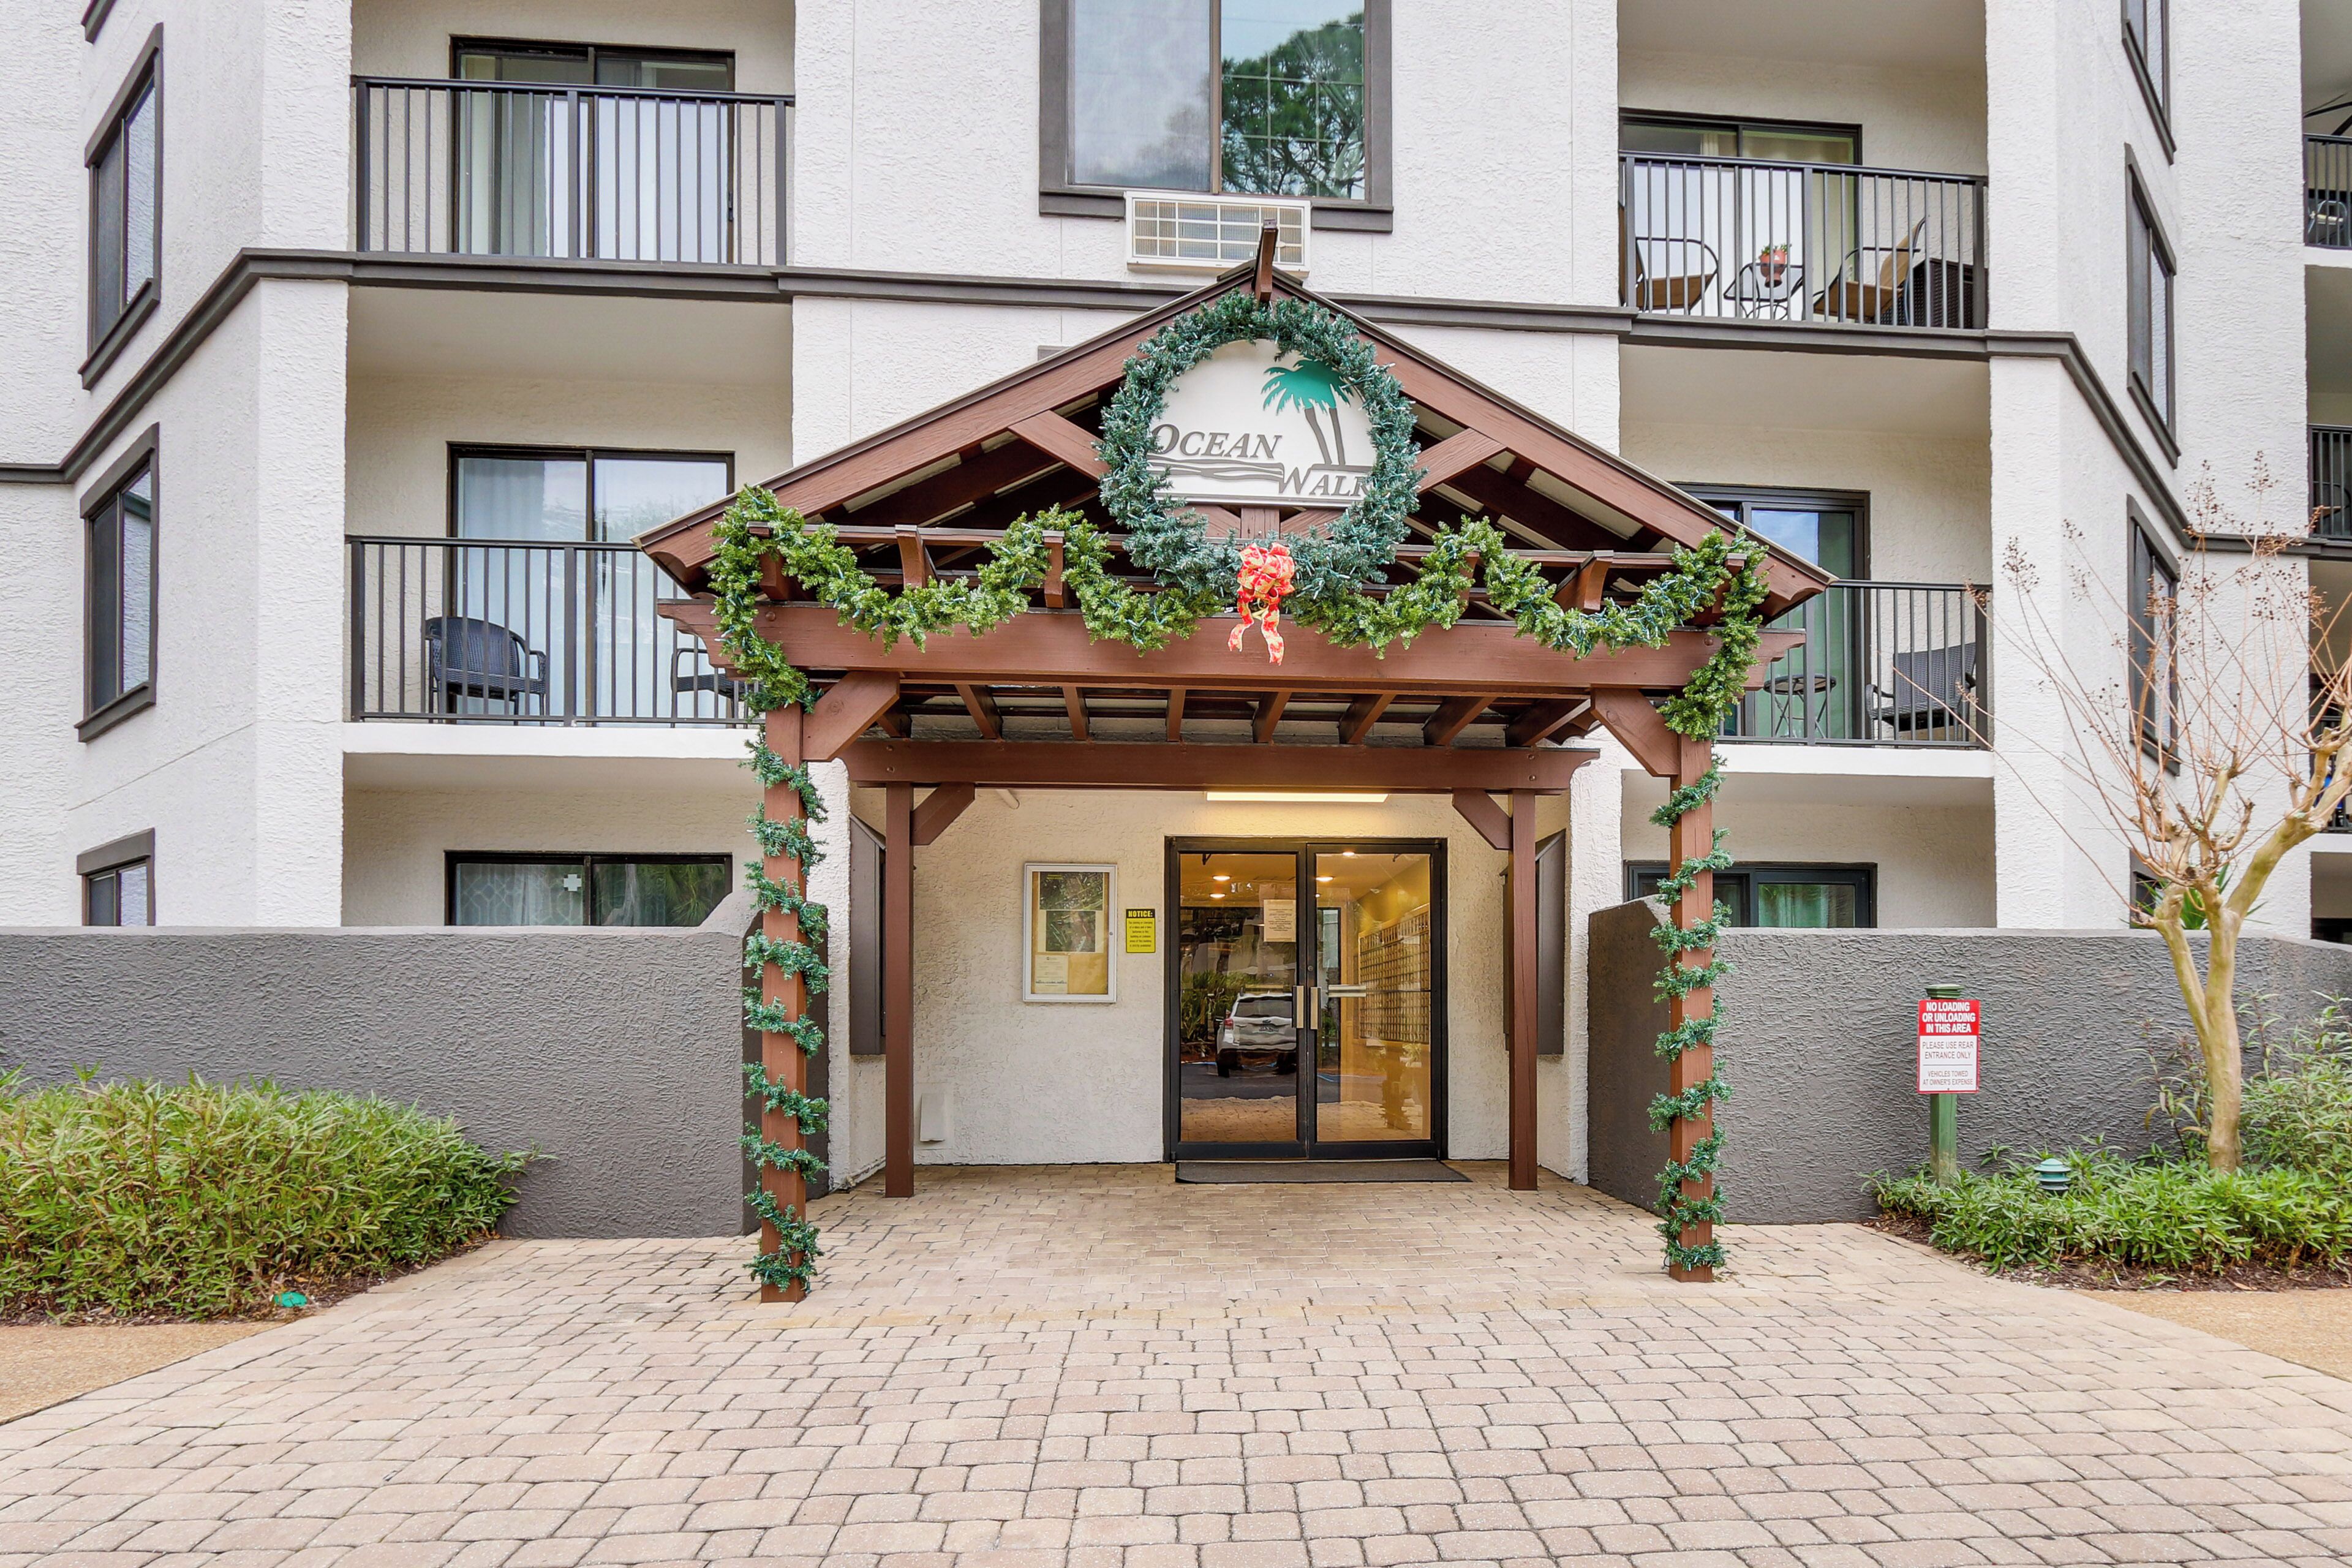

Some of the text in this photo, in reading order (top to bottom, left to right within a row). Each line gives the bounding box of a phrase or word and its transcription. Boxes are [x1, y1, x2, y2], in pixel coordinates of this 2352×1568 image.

[1150, 423, 1283, 459] OCEAN
[1926, 1002, 1970, 1011] NO LOADING
[1922, 1012, 1976, 1022] OR UNLOADING
[1926, 1023, 1972, 1033] IN THIS AREA
